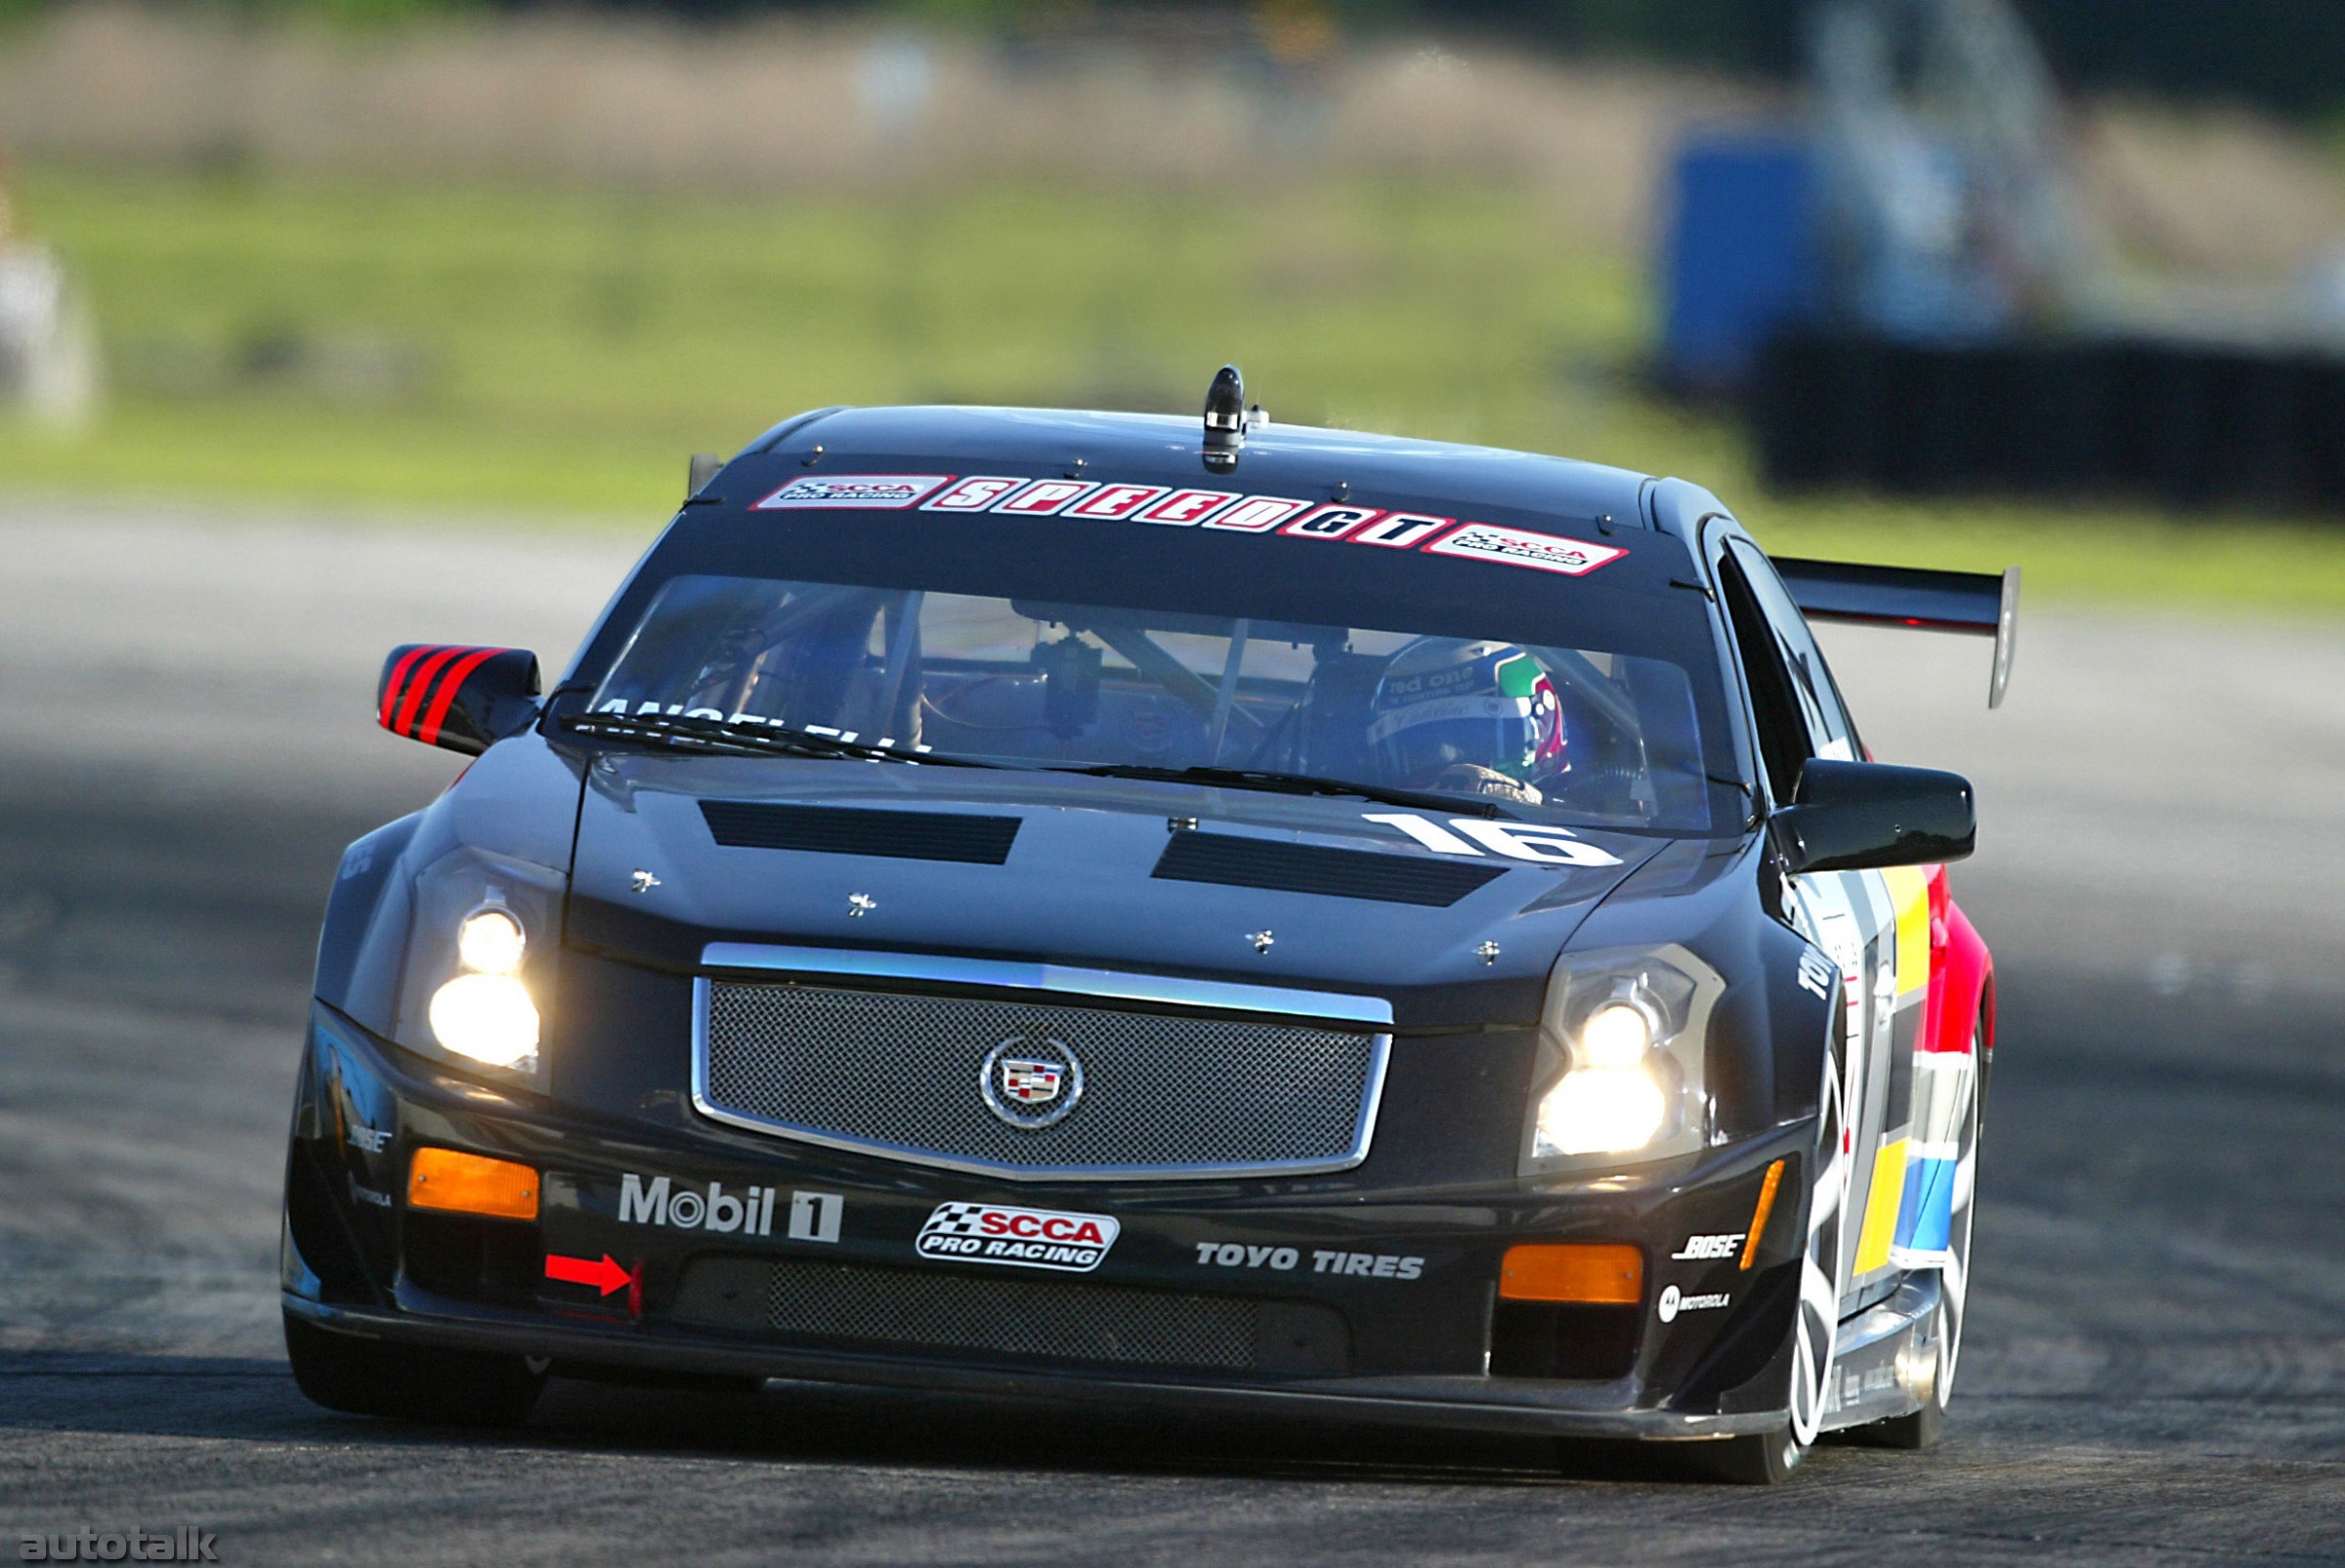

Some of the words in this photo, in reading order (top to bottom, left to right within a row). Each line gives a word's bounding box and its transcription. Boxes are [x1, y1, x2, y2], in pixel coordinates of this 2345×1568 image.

[1456, 540, 1499, 550] PRO
[1501, 546, 1583, 566] RACING
[1500, 537, 1587, 560] SCCA
[1361, 814, 1624, 867] 16
[618, 1173, 775, 1236] Mobil
[980, 1212, 1103, 1245] SCCA
[922, 1236, 981, 1253] PRO
[984, 1241, 1097, 1265] RACING
[1196, 1242, 1299, 1270] TOYO
[1312, 1250, 1426, 1280] TIRES
[1671, 1234, 1746, 1259] BOSE
[1679, 1293, 1730, 1310] MOTOROLA
